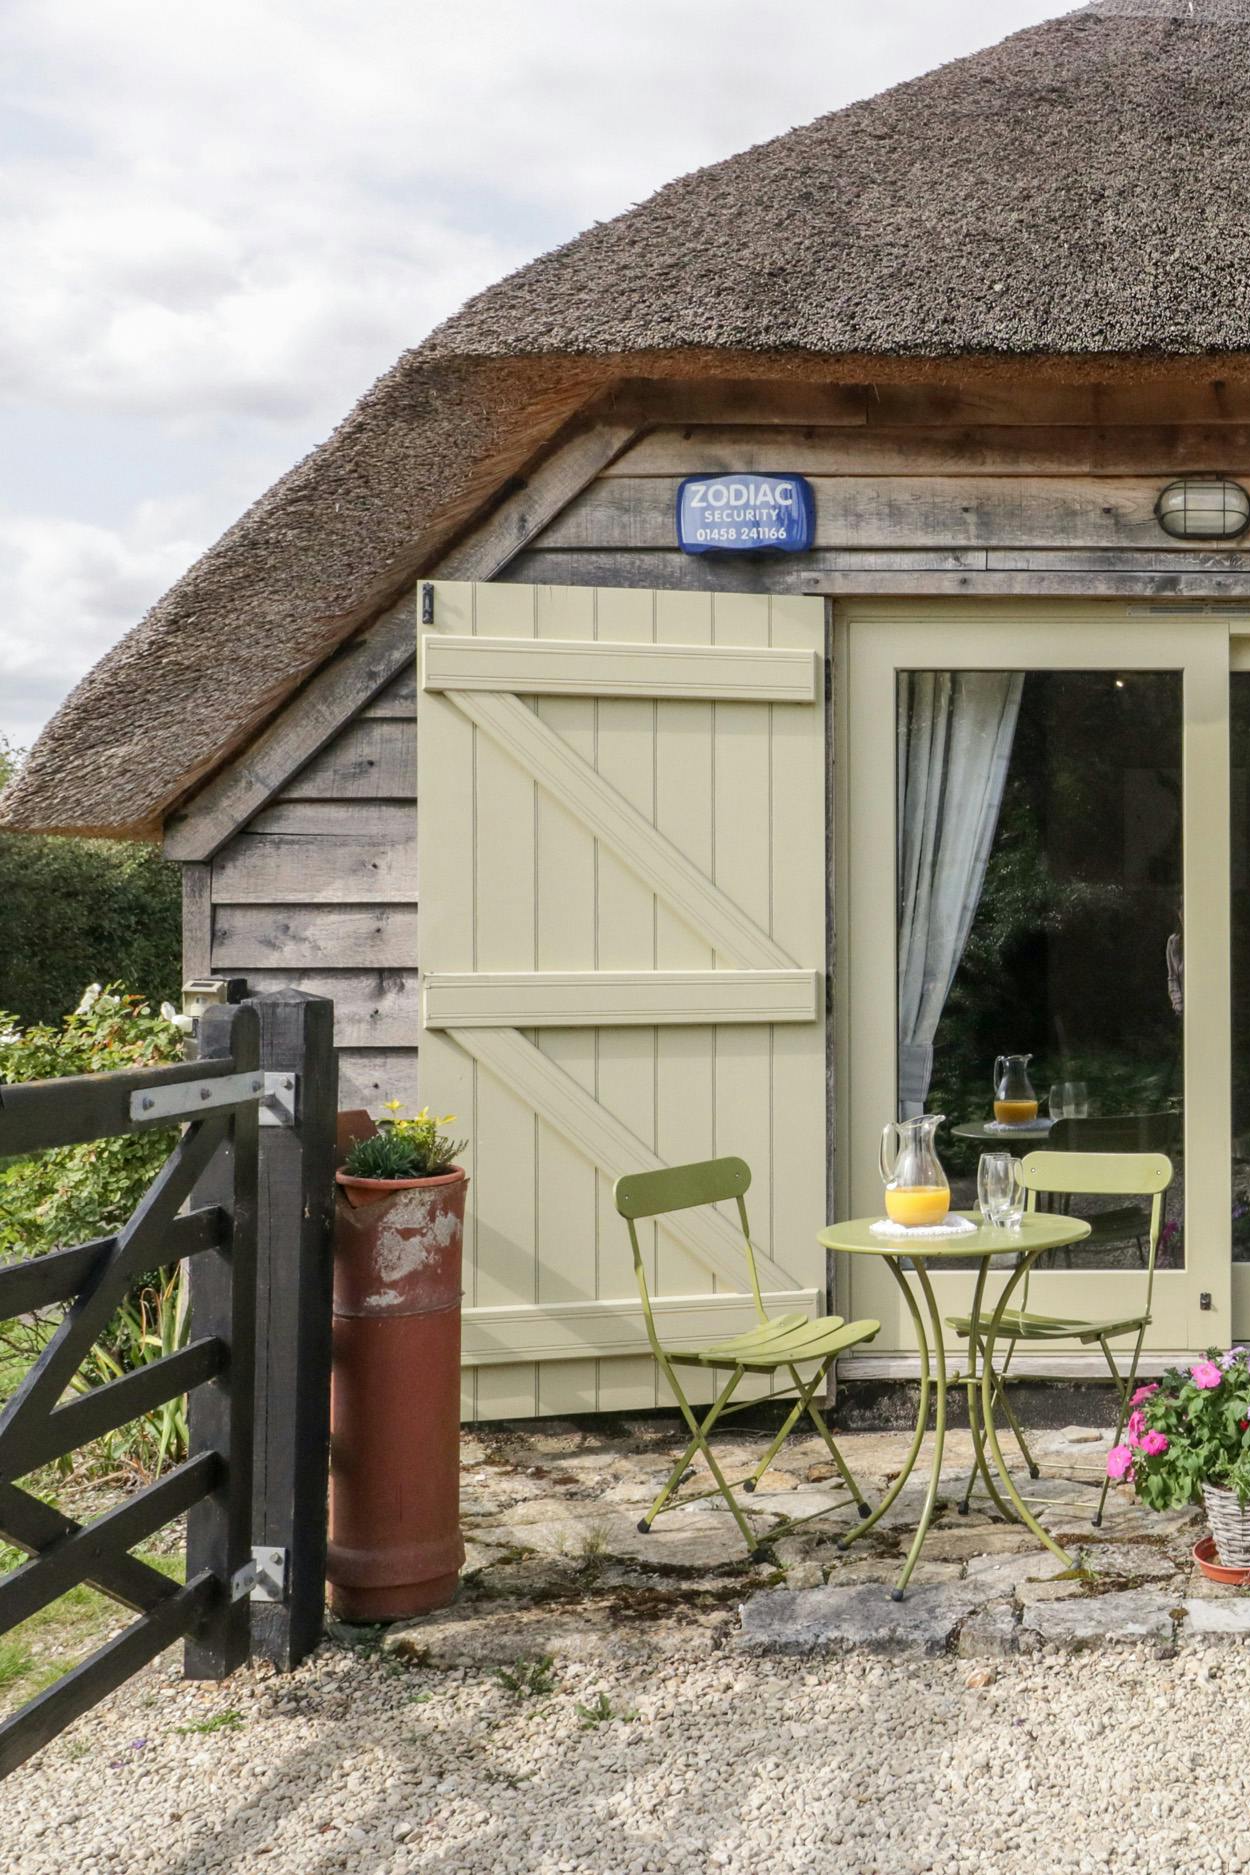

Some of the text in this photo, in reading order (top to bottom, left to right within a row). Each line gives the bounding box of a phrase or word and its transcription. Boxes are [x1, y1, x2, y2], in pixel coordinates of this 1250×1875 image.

[690, 484, 793, 508] ZODIAC
[704, 509, 779, 522] SECURITY
[696, 528, 787, 541] 01458 241166
